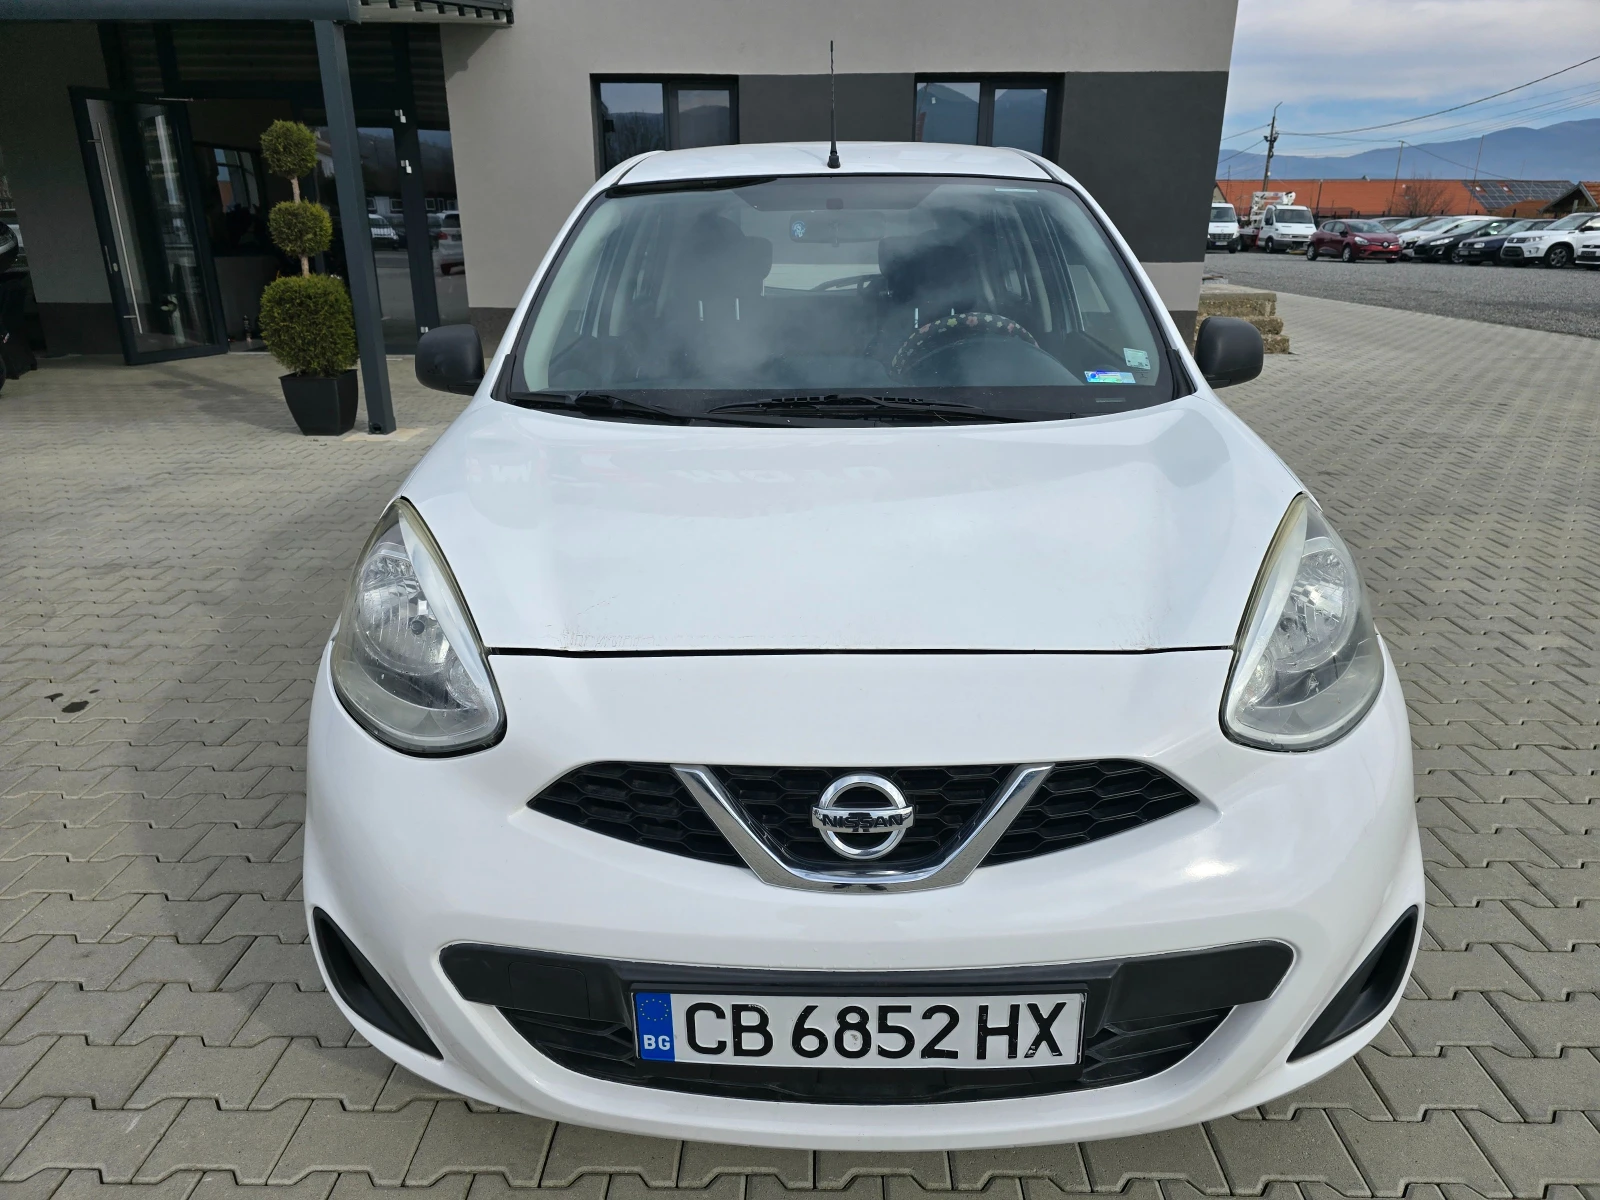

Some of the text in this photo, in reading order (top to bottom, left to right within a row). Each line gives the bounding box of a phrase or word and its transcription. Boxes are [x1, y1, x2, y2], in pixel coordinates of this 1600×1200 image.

[822, 813, 904, 828] NISSAN
[685, 1001, 1067, 1060] CB 6852 HX
[643, 1034, 671, 1051] BG
